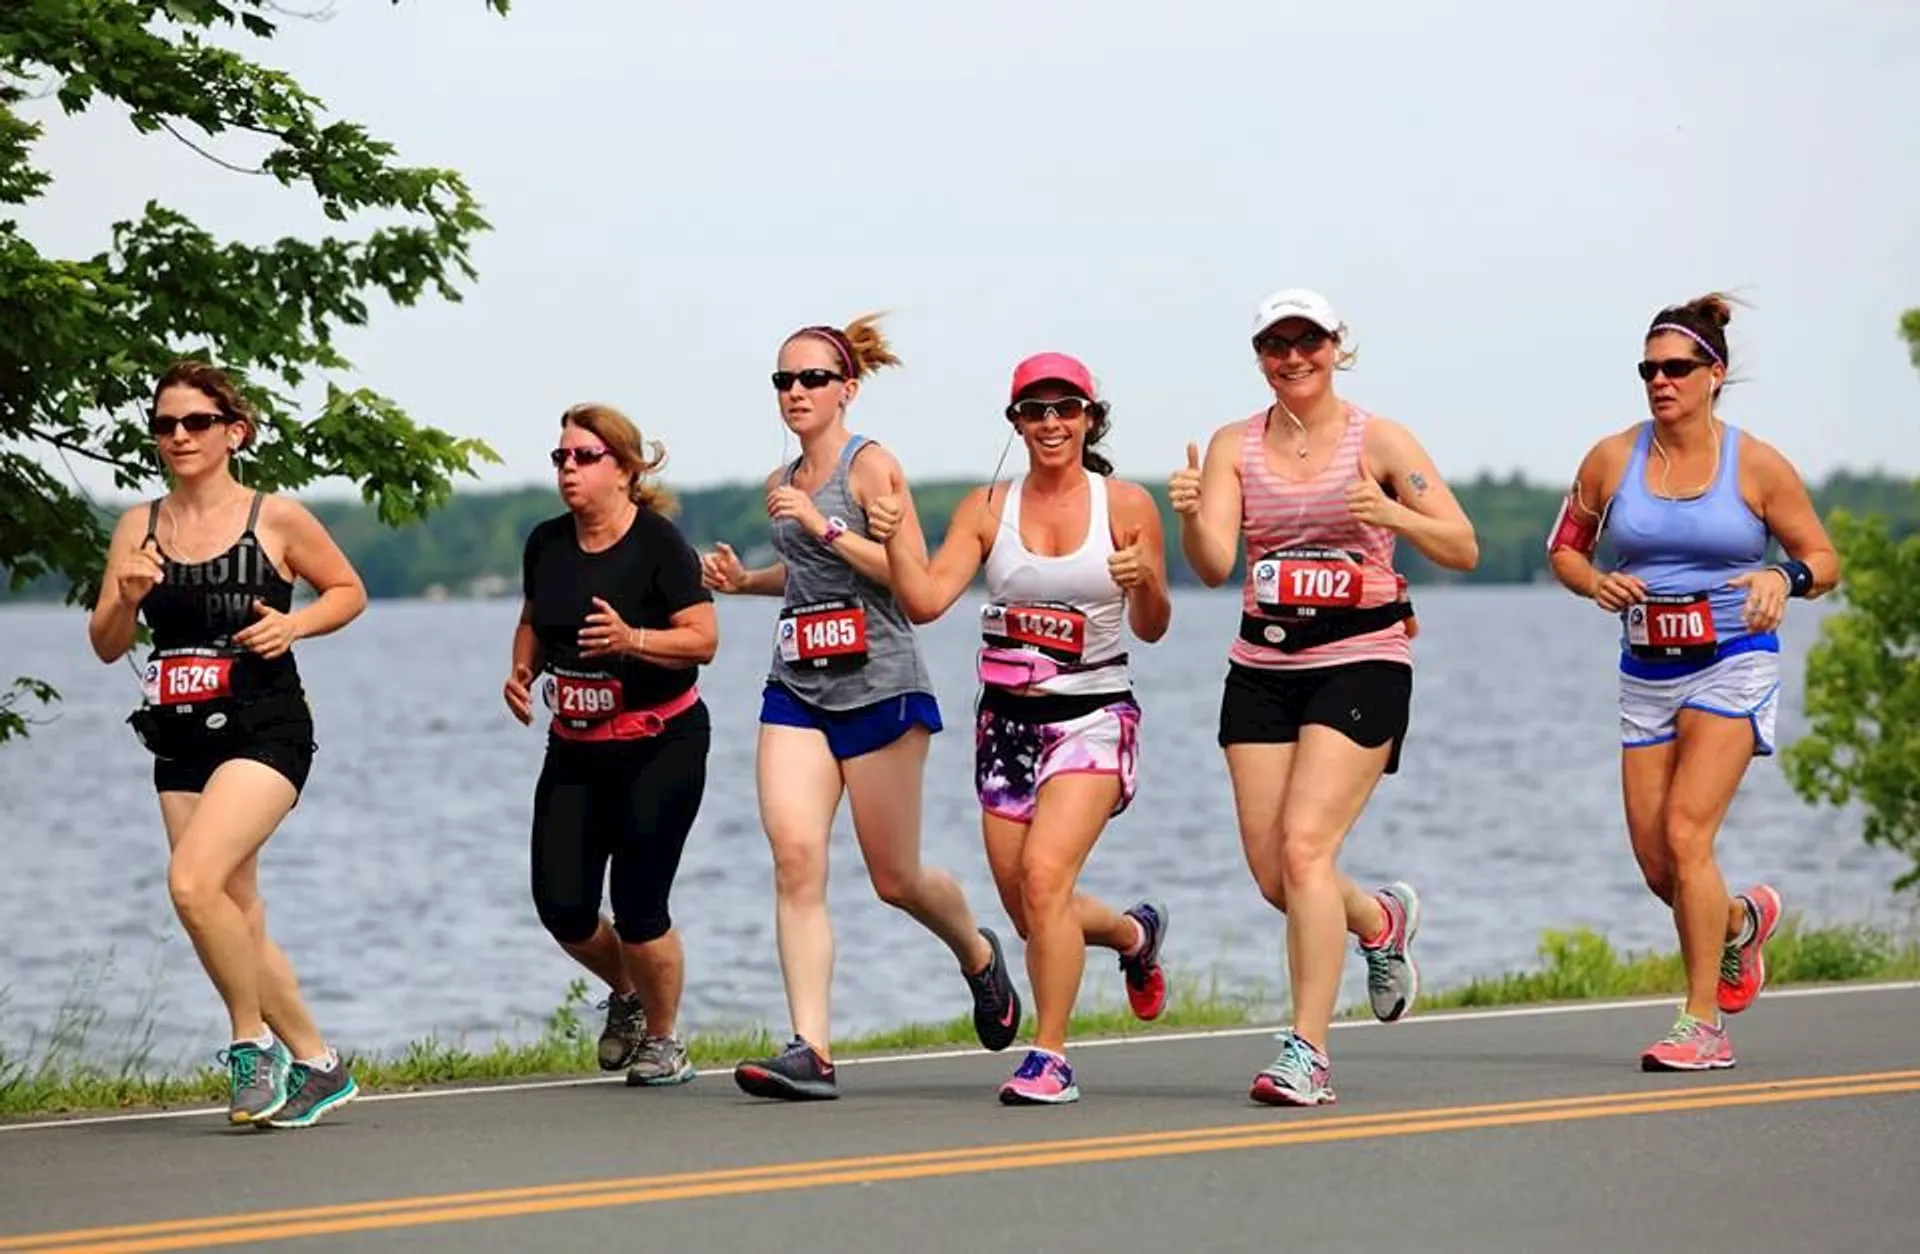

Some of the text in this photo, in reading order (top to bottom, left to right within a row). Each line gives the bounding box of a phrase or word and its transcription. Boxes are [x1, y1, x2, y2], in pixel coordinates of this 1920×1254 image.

[1291, 568, 1350, 598] 1702
[803, 618, 857, 650] 1485
[1016, 611, 1074, 643] 1422
[1656, 611, 1704, 638] 1770
[167, 665, 219, 695] 1526
[562, 685, 616, 712] 2199
